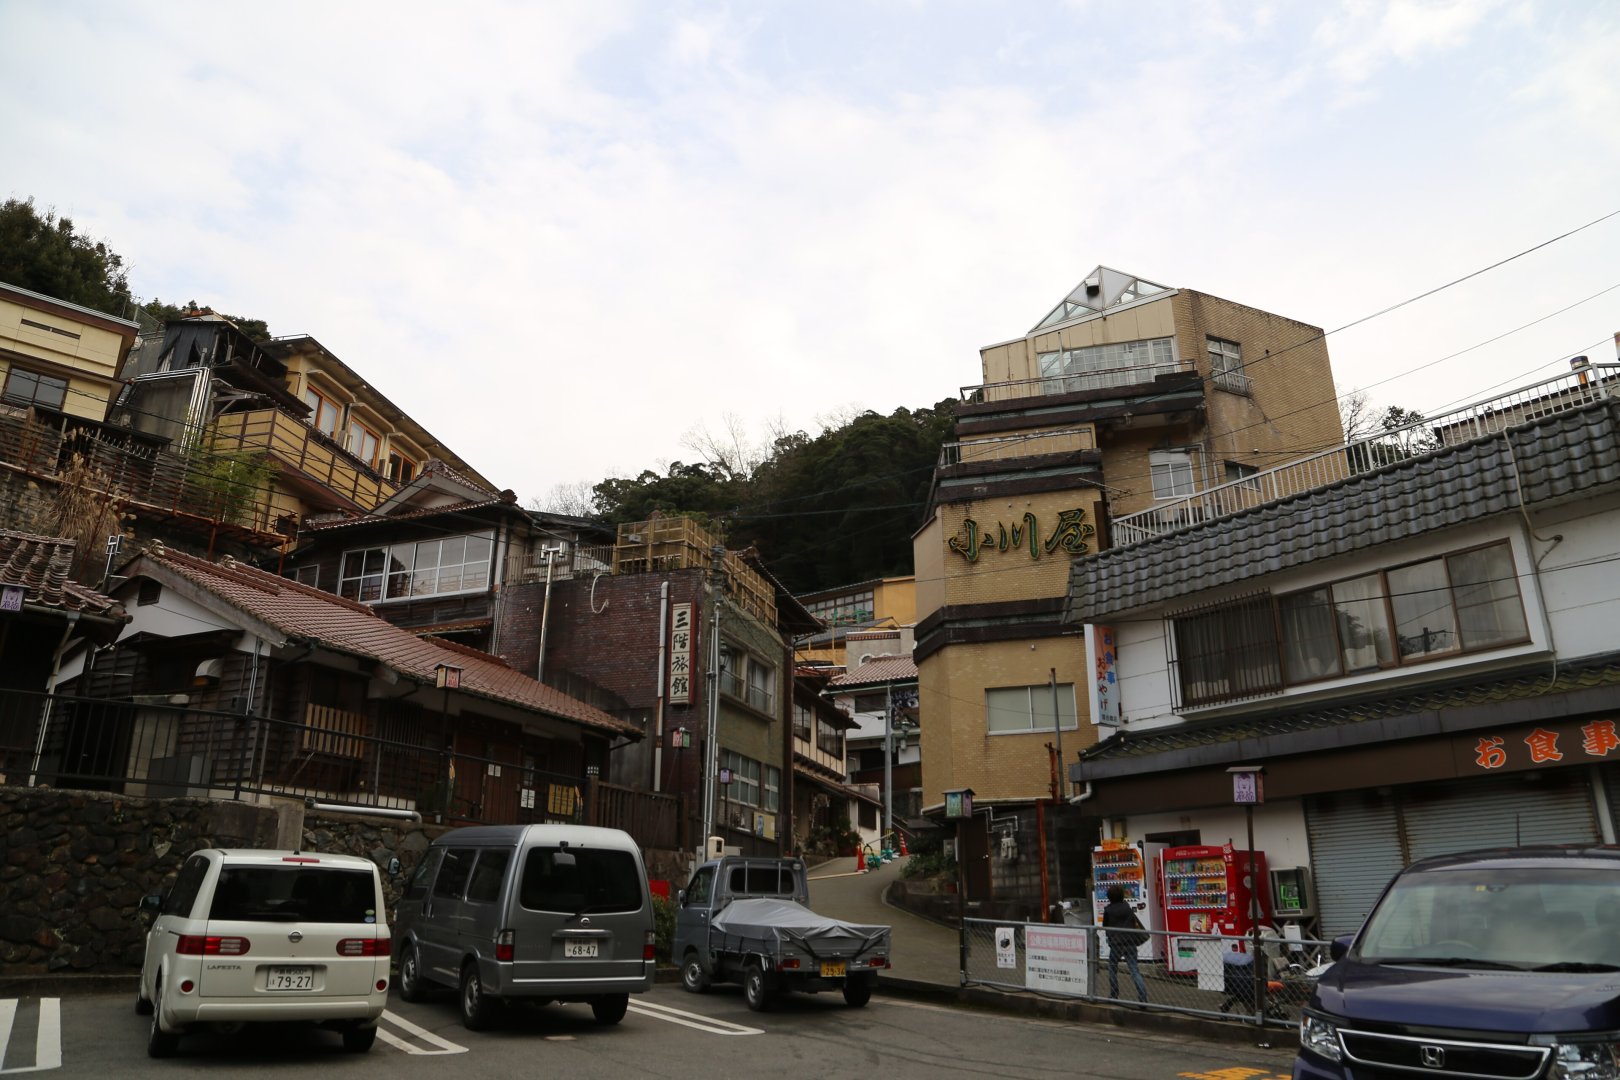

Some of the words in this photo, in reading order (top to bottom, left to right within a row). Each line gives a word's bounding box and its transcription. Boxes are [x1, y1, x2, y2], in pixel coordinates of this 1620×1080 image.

[948, 508, 1095, 561] 小川屋
[671, 611, 689, 695] 三階旅館
[1474, 720, 1620, 769] お食事
[572, 945, 596, 956] 68-47
[277, 976, 311, 988] 79-27
